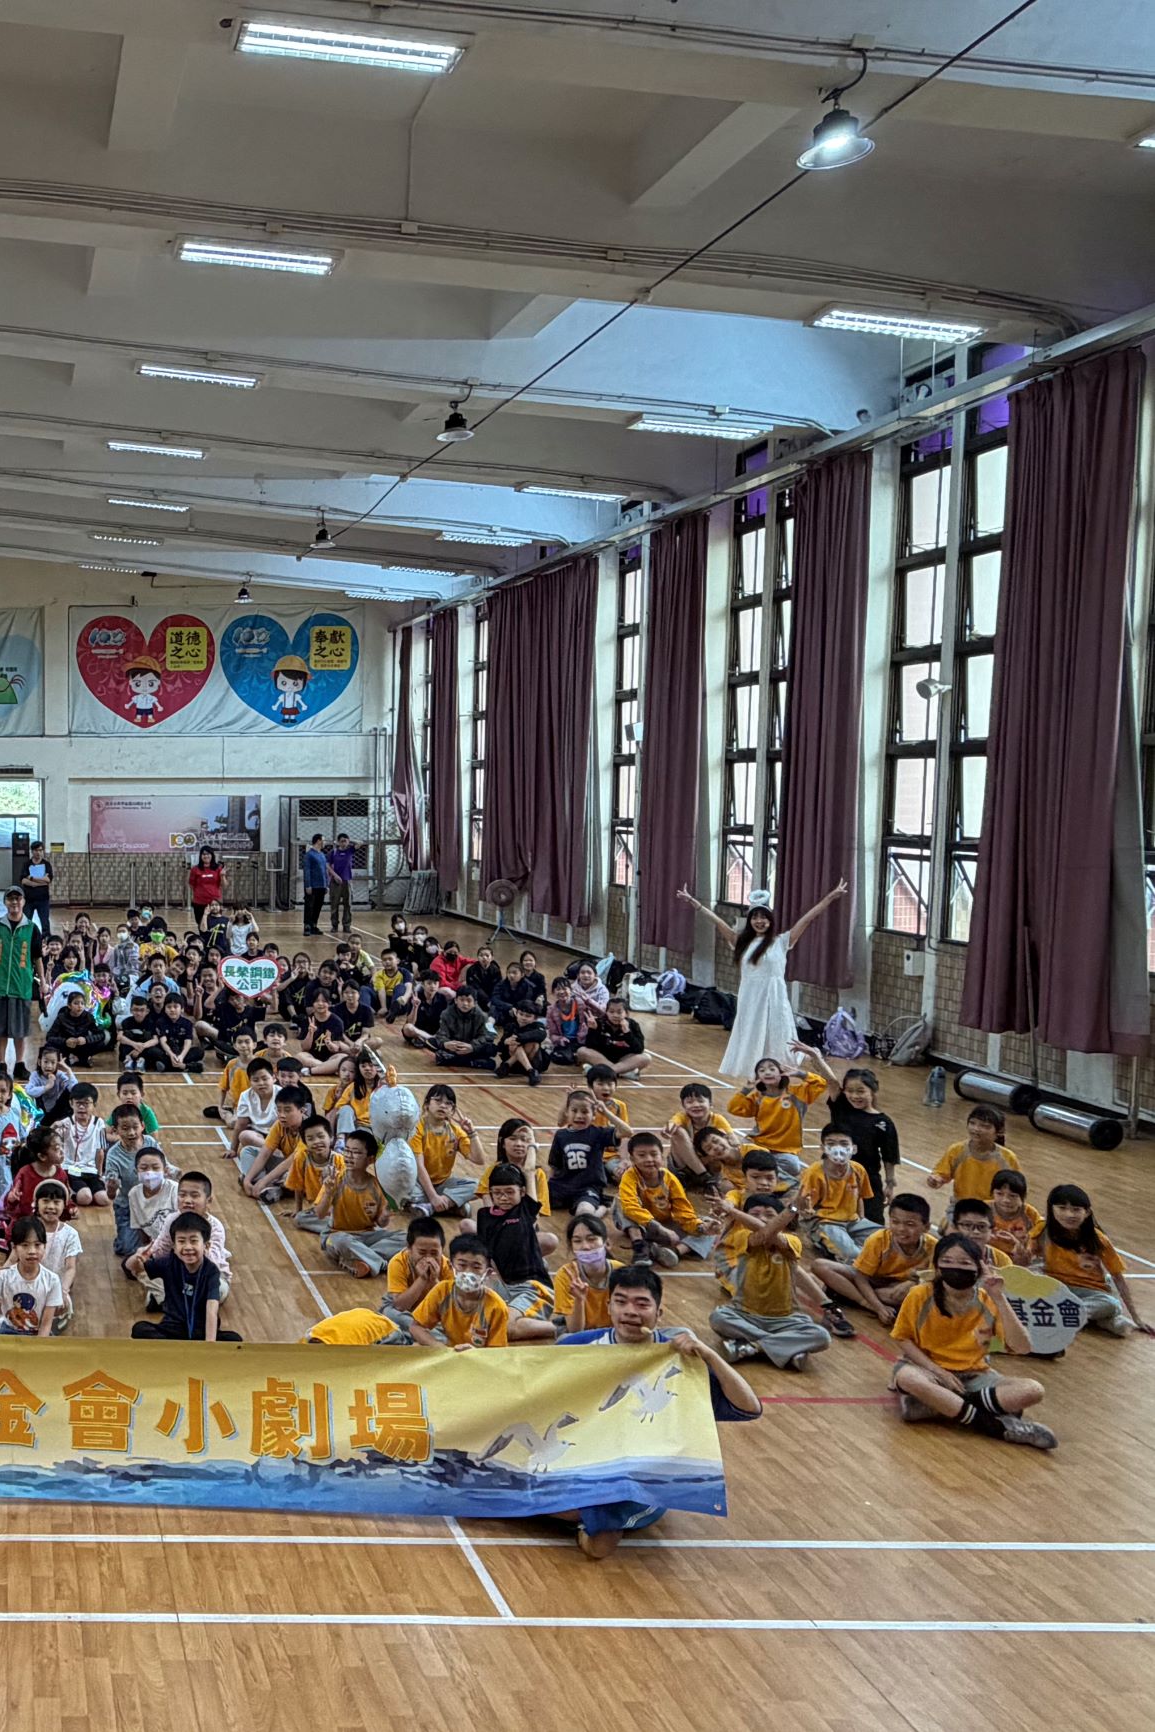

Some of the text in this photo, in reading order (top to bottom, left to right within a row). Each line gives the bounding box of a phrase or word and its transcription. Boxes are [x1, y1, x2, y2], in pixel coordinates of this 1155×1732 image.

[169, 630, 201, 646] 道德
[314, 629, 346, 645] 奉獻
[169, 646, 201, 659] 之心
[313, 645, 345, 658] 之心
[223, 965, 276, 979] 長榮鋼鐵
[237, 979, 263, 991] 公司
[567, 1151, 587, 1169] 26
